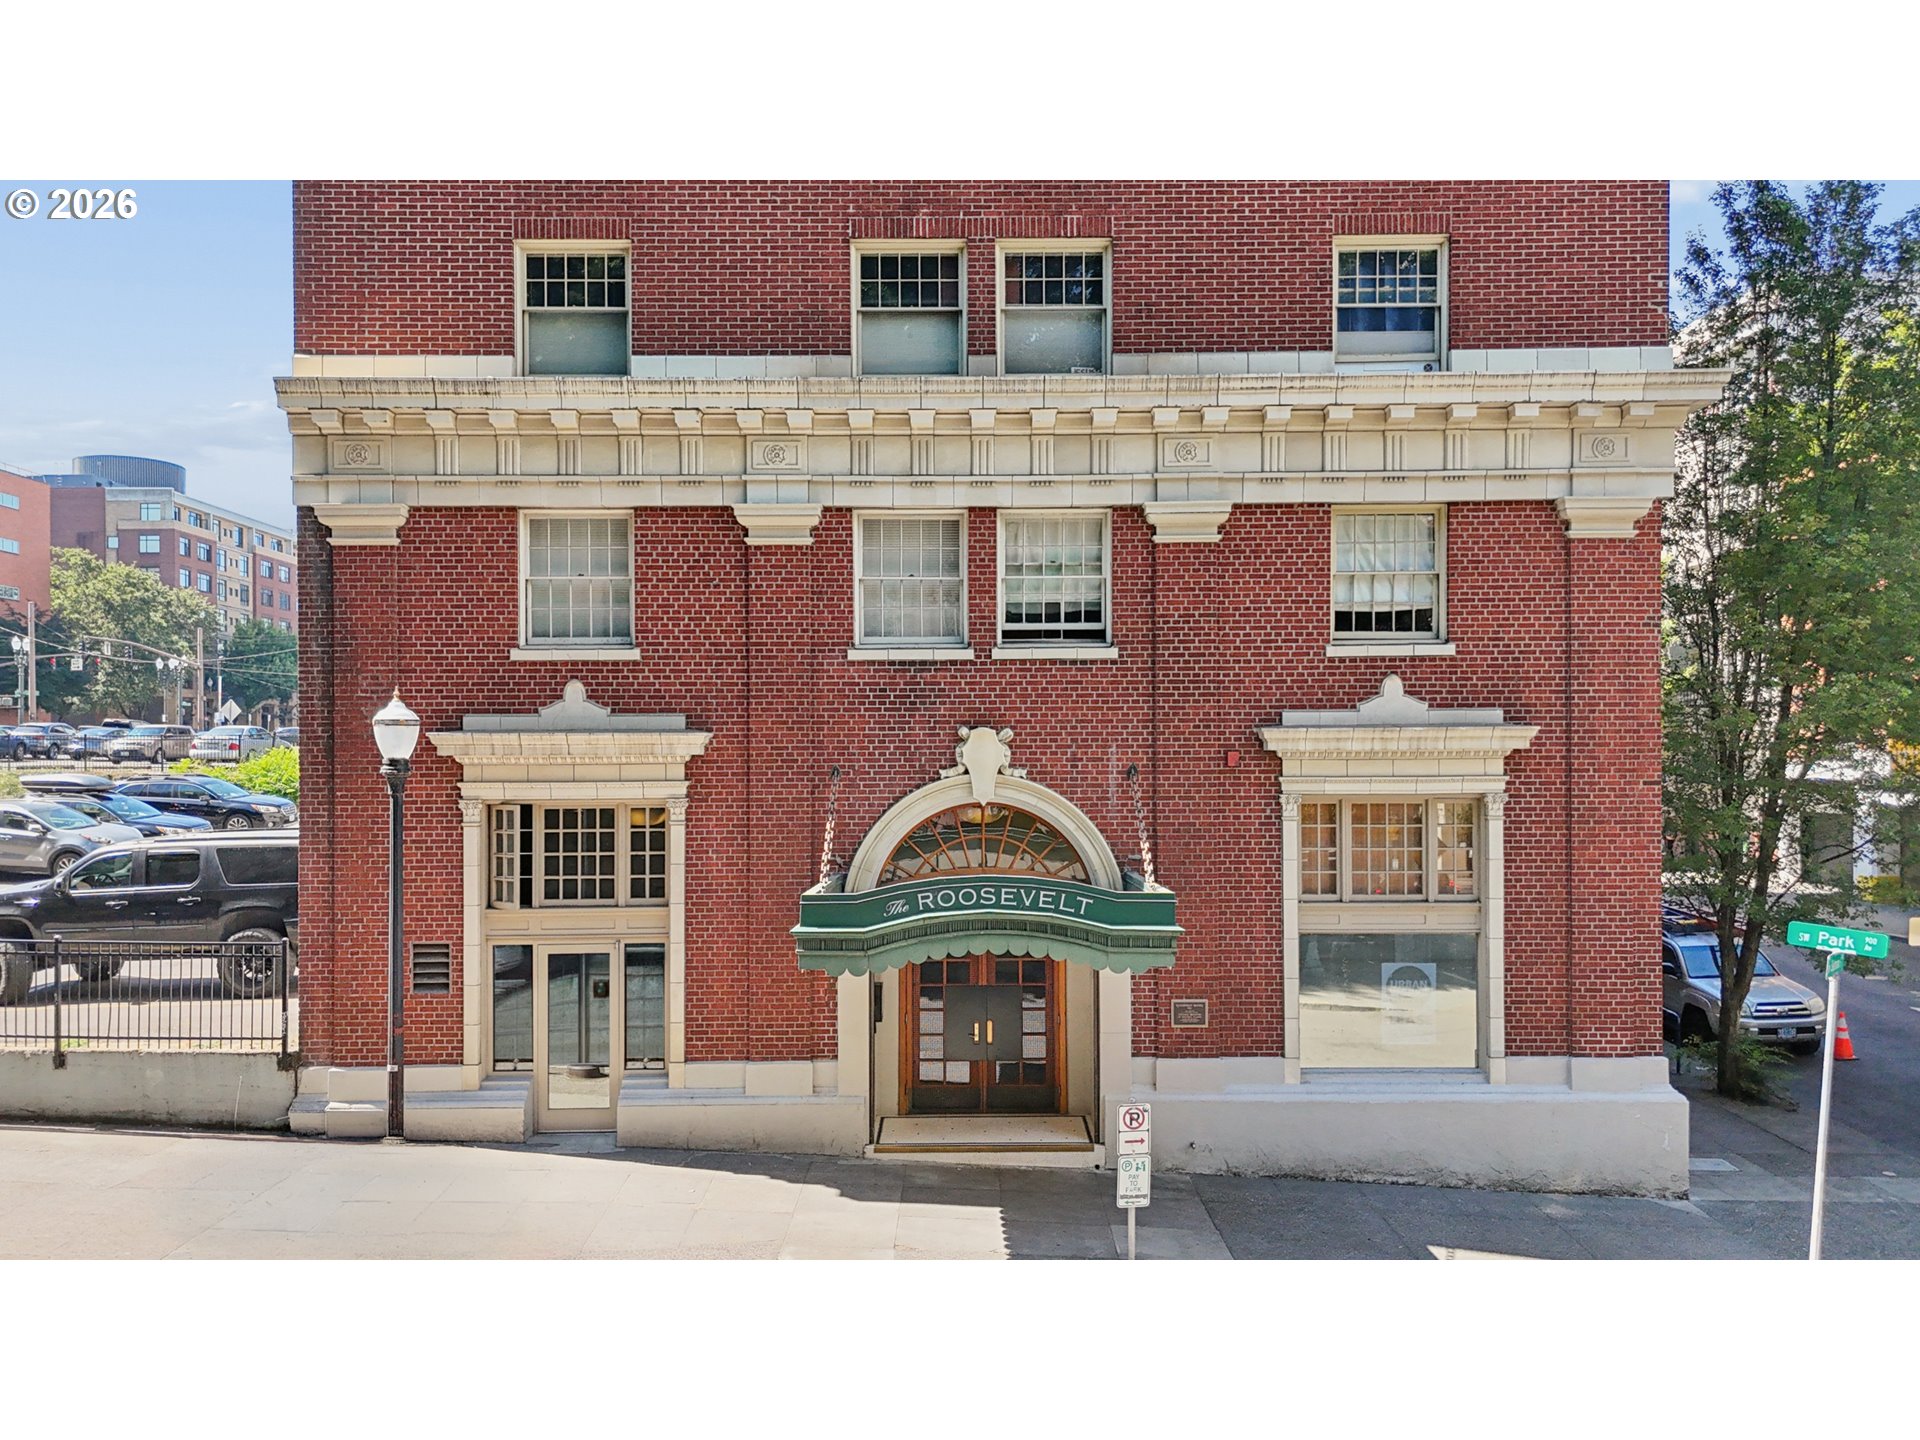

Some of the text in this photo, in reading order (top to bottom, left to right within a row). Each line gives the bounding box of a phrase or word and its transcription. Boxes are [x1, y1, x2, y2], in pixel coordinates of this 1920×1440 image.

[883, 887, 1094, 917] The ROOSEVELT
[1799, 931, 1855, 949] SW Park
[1865, 937, 1878, 945] 900
